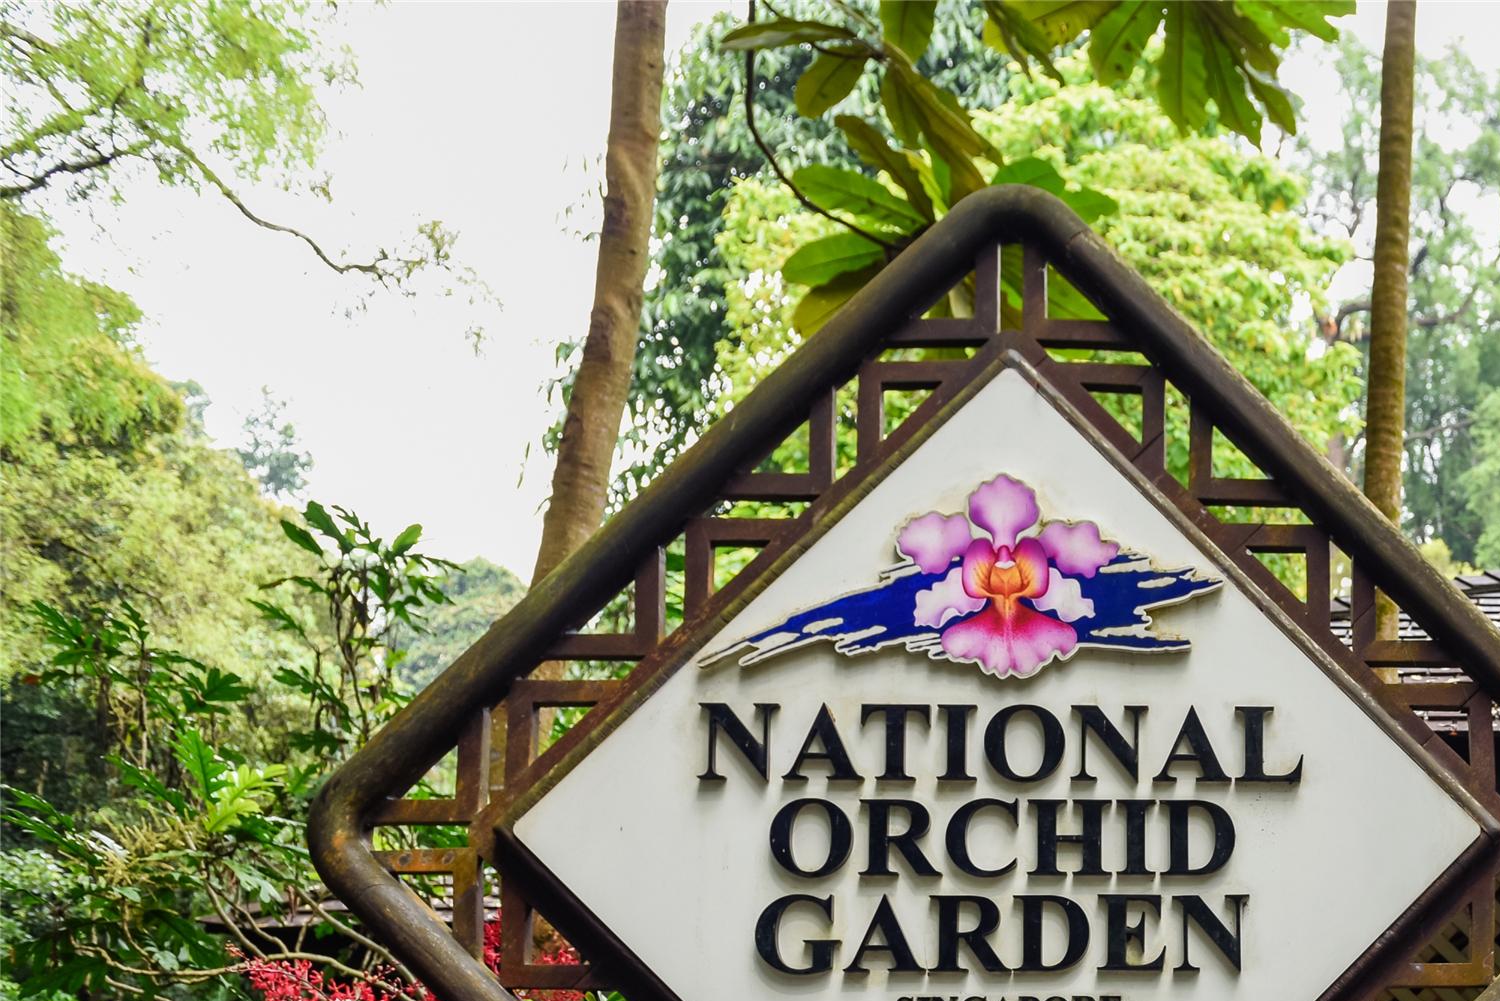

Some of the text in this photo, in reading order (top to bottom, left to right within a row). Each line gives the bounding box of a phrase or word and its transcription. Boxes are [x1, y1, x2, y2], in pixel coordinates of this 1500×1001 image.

[696, 702, 1304, 785] NATIONAL
[769, 798, 1236, 879] ORCHID
[754, 894, 1250, 975] GARDEN
